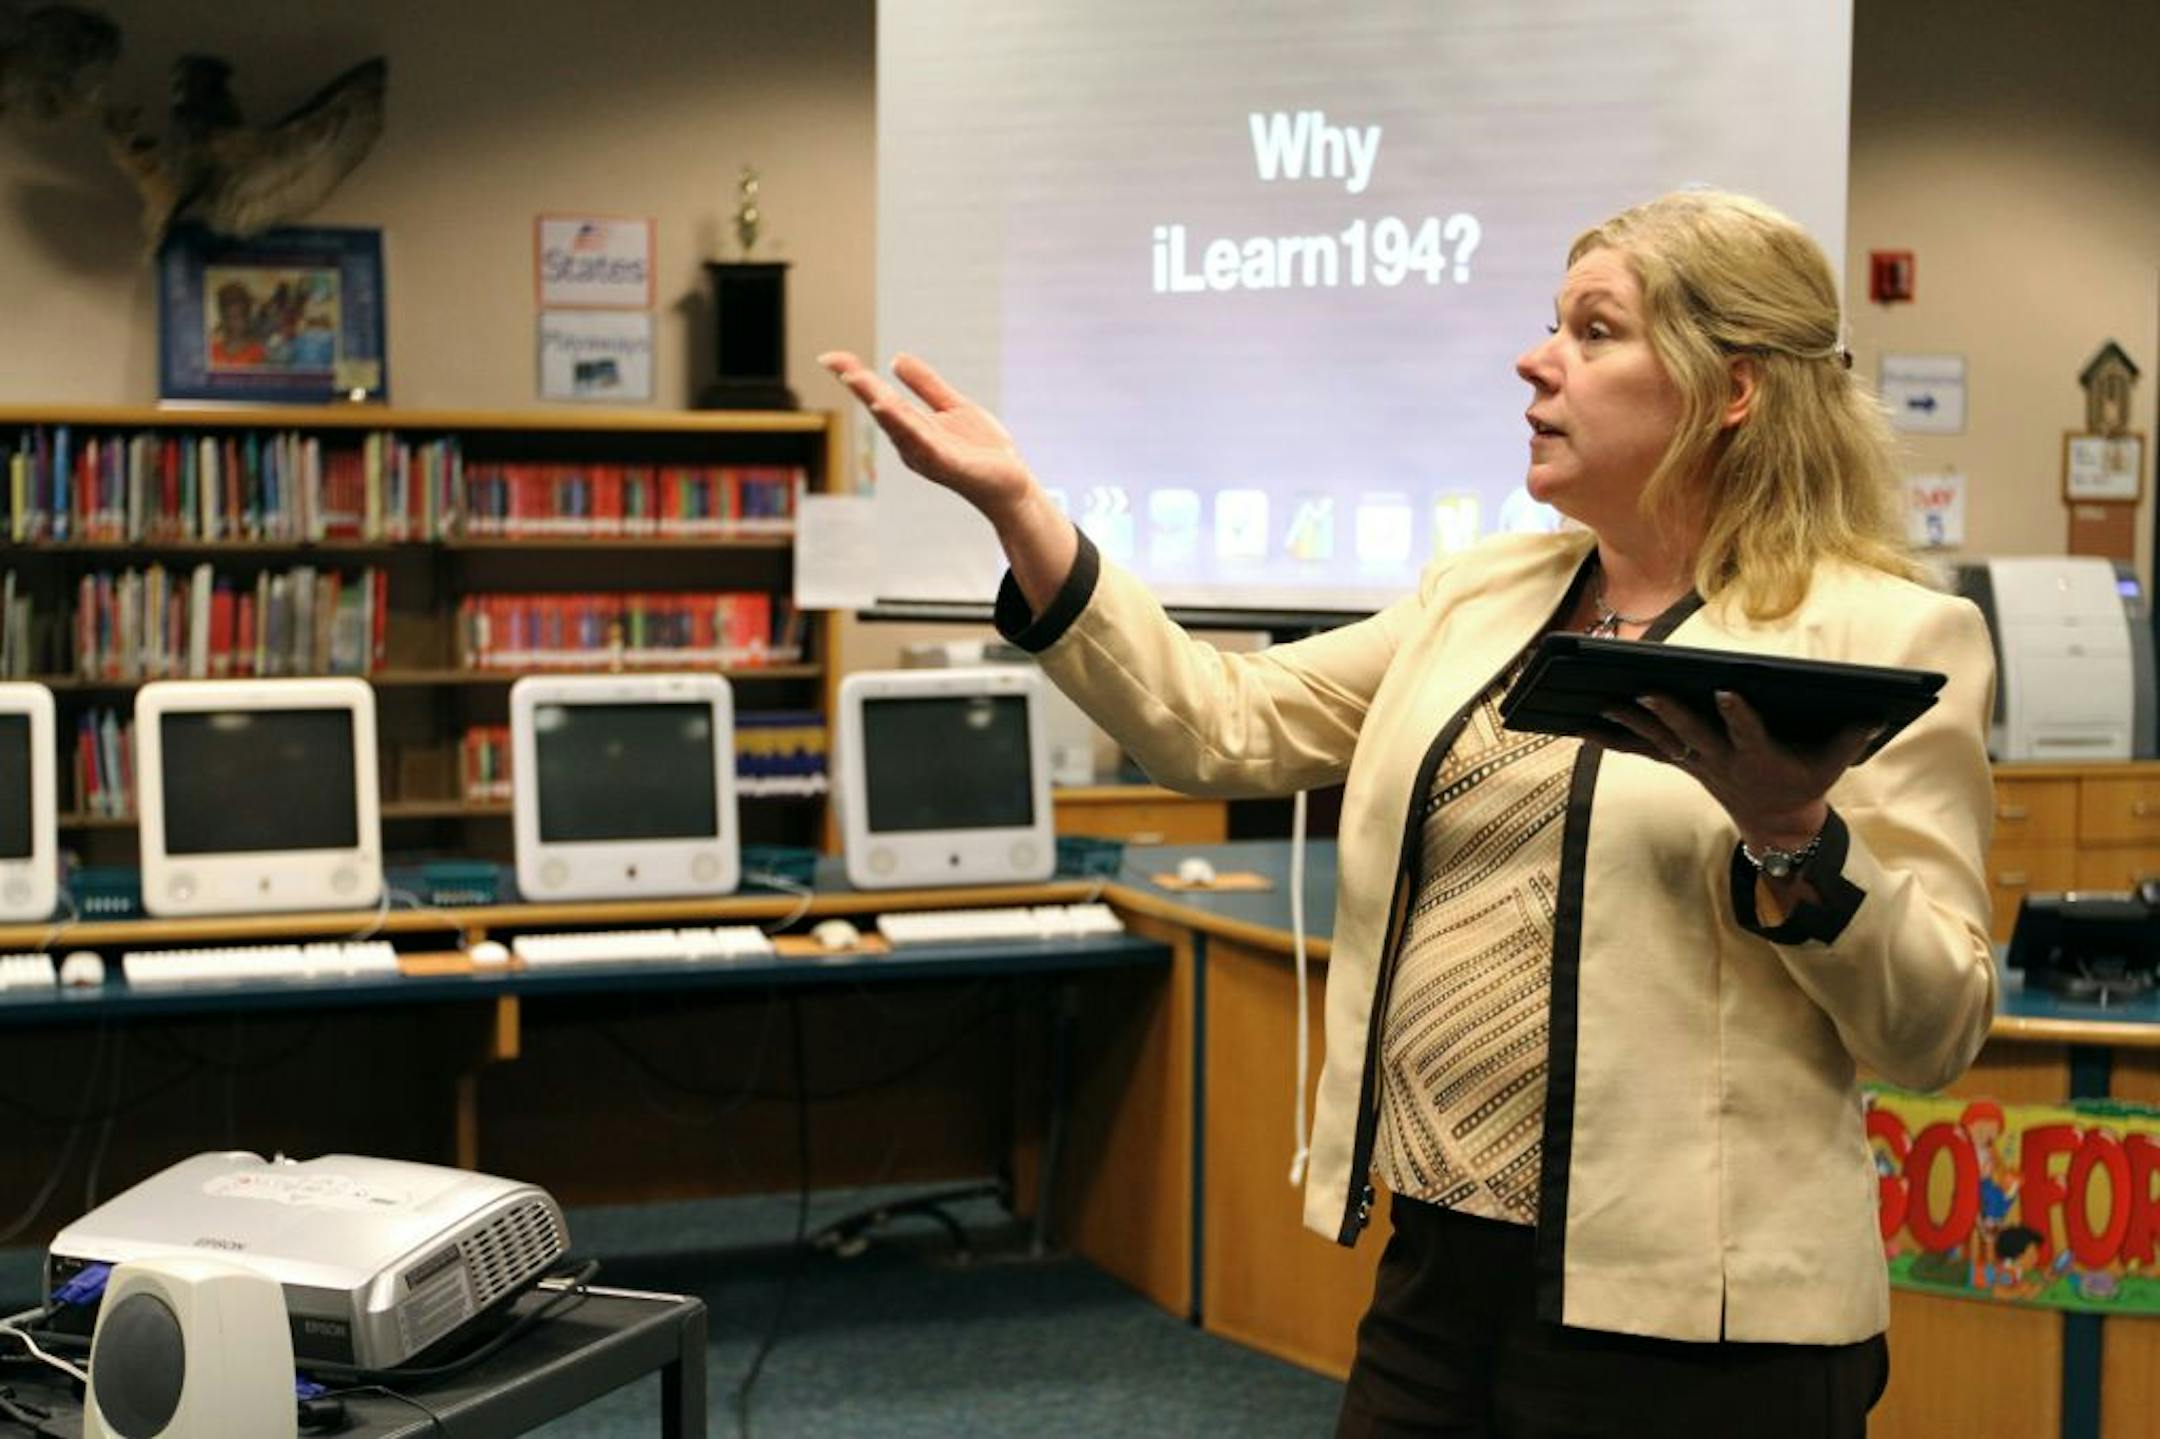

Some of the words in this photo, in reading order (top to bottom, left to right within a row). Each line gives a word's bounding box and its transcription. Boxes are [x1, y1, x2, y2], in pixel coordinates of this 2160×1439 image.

[1248, 110, 1382, 194] Why
[1152, 212, 1482, 293] iLearn194?
[304, 1319, 347, 1338] EPSON
